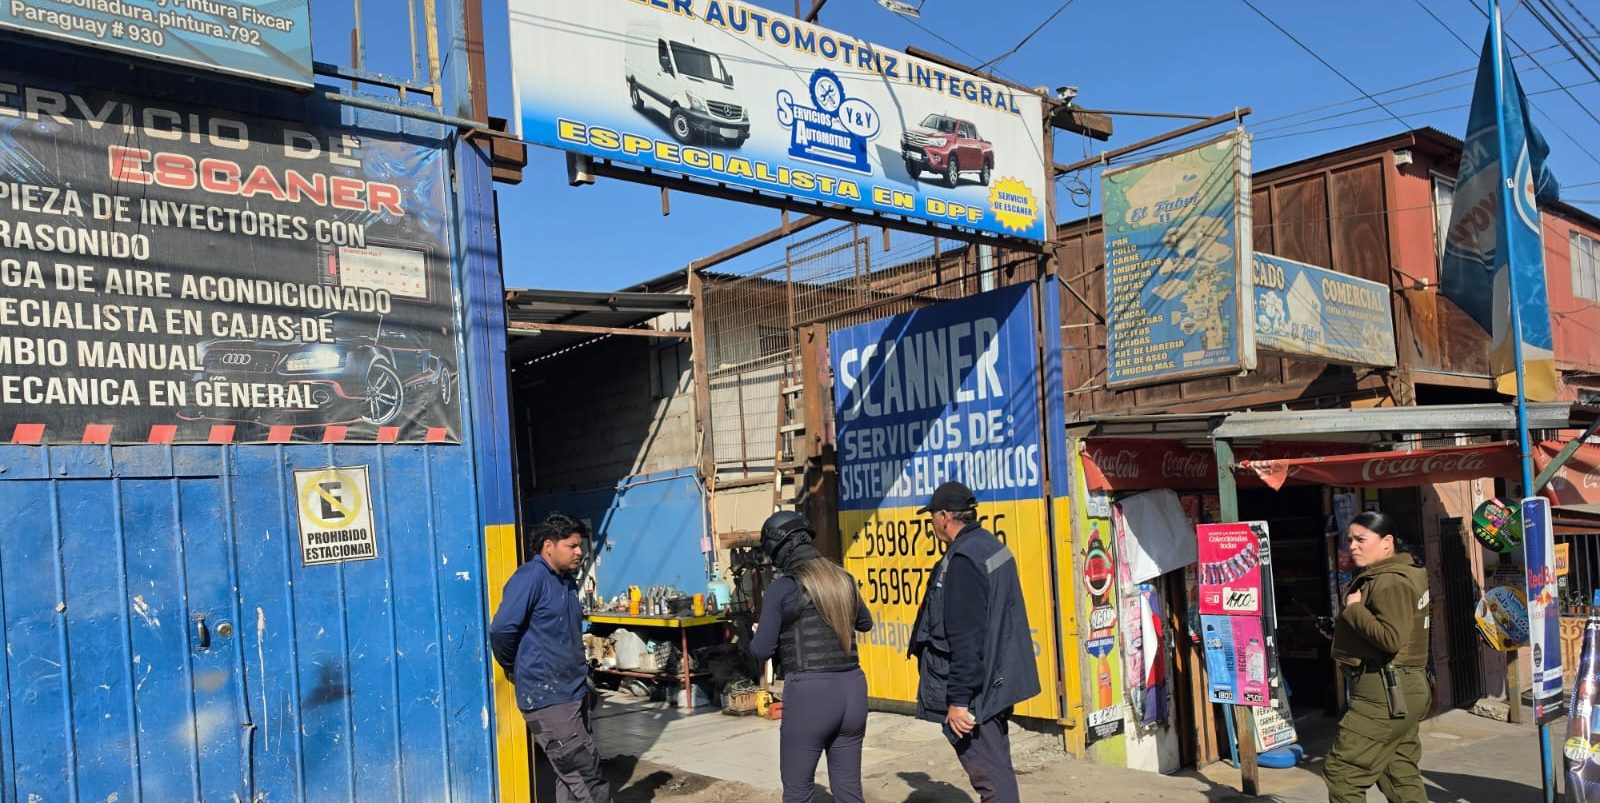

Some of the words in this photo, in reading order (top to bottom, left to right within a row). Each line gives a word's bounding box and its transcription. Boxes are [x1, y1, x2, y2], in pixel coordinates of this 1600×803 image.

[11, 1, 108, 37] Paraguay
[112, 21, 125, 37] #
[128, 26, 163, 47] 930
[241, 6, 293, 31] Fixcar
[703, 0, 899, 79] AUTOMOTRIZ
[906, 61, 1021, 115] INTEGRAL
[283, 129, 361, 167] DE
[108, 144, 405, 217] ESCANER
[557, 118, 861, 200] ESPECIALISTA
[872, 186, 915, 210] EN
[926, 197, 983, 222] DPF
[998, 191, 1028, 204] SERVICIO
[1004, 203, 1032, 216] ESCANER
[92, 192, 131, 223] DE
[141, 199, 308, 241] INYECTORES
[315, 219, 365, 248] CON
[54, 263, 95, 293] DE
[104, 267, 171, 298] AIRE
[181, 274, 391, 315] ACONDICIONADO
[1321, 277, 1385, 312] COMERCIAL
[166, 309, 203, 336] EN
[211, 311, 295, 341] CAJAS
[300, 316, 335, 343] DE
[77, 339, 204, 371] MANUAL
[840, 317, 1003, 421] SCANNER
[150, 380, 186, 406] EN
[195, 380, 319, 409] GENERAL
[844, 412, 961, 461] SERVICIOS
[841, 458, 912, 501] SISTEMAS
[914, 444, 1038, 496] ELECTRONICOS
[305, 542, 372, 561] ESTACIONAR
[307, 528, 367, 545] PROHIBIDO
